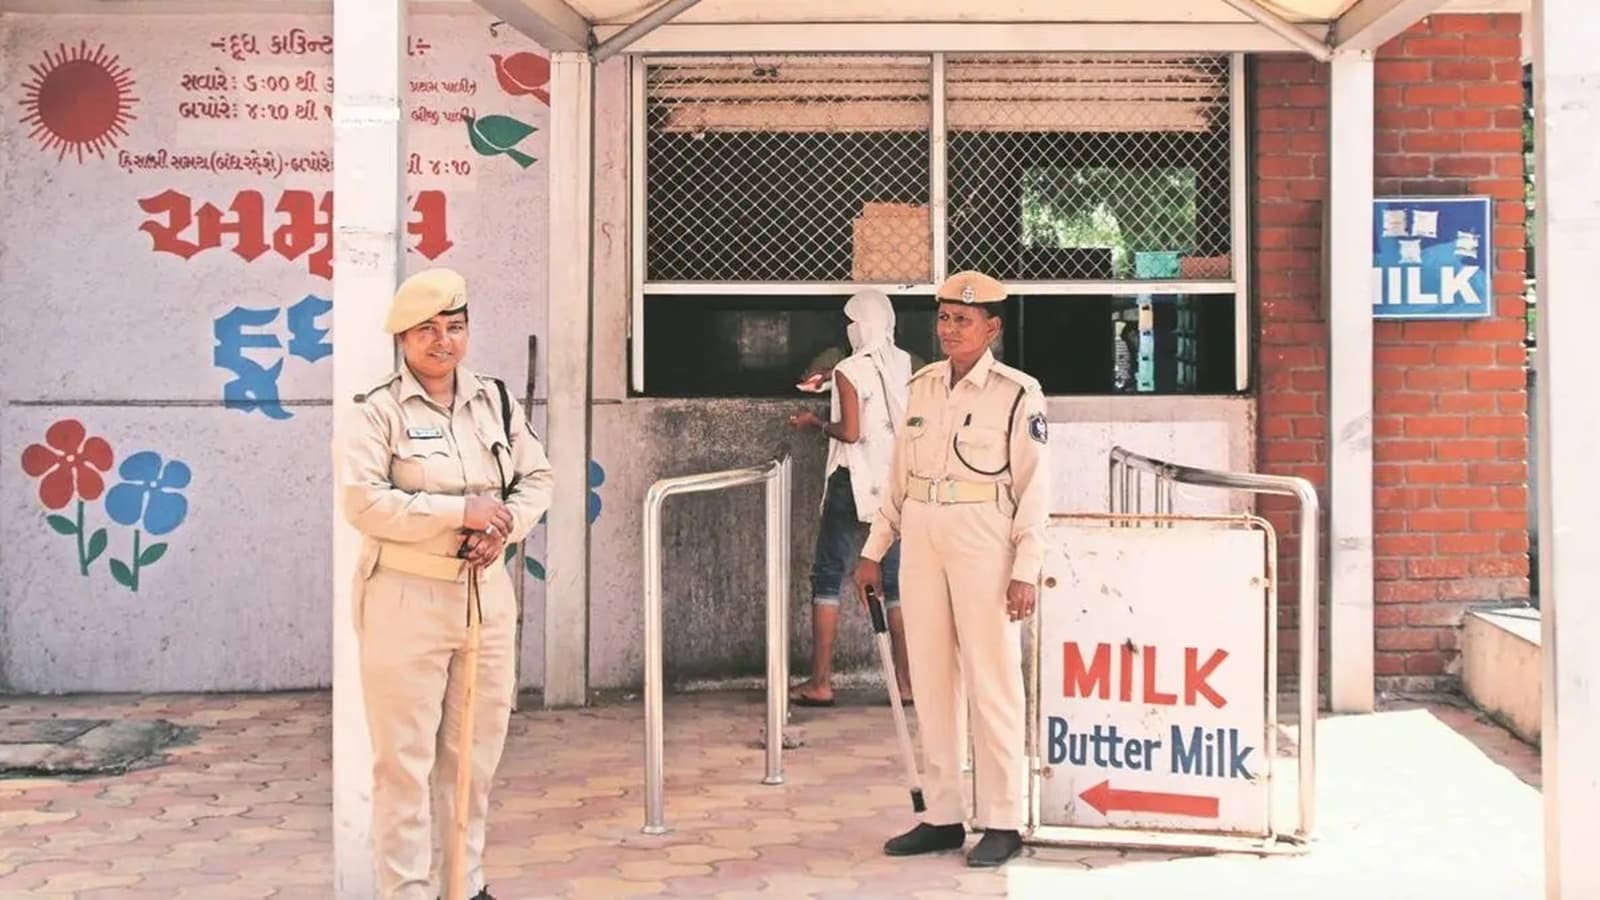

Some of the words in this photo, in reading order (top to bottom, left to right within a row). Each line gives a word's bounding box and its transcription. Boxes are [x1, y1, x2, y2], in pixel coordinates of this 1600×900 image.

[1063, 641, 1230, 709] MILK
[1048, 716, 1162, 771] Butter
[1170, 724, 1256, 780] Milk
